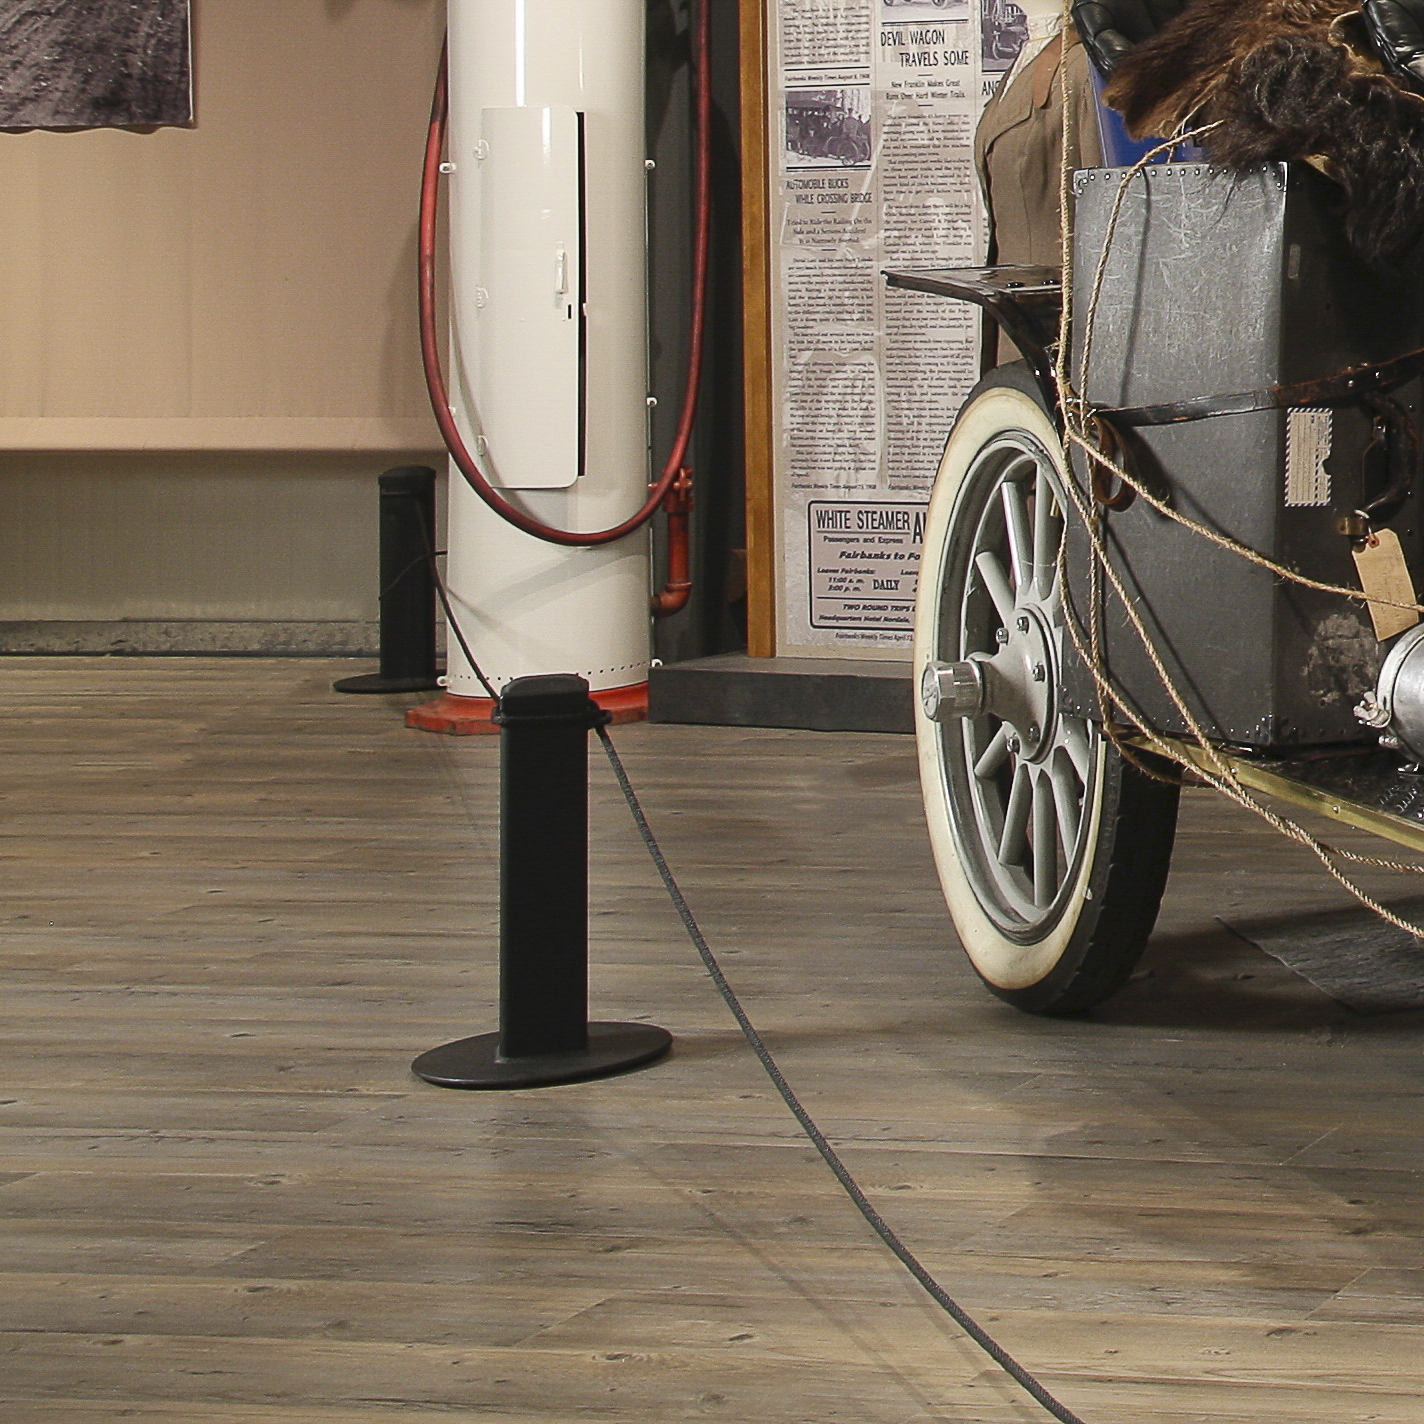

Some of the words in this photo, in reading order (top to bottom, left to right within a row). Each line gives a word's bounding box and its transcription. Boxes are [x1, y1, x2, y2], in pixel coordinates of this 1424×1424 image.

[880, 31, 905, 46] DEVIL
[909, 29, 945, 45] WAGON
[899, 51, 939, 67] TRAVELS
[943, 50, 969, 66] SOME
[785, 178, 826, 190] AUTOMOBILE
[794, 193, 815, 204] WHILE
[816, 192, 849, 204] CROSSING
[850, 192, 873, 204] BRIDGE
[816, 510, 851, 529] WHITE
[856, 510, 911, 531] STEAMER
[823, 535, 860, 544] Passengers
[839, 550, 892, 560] Fairbanks
[894, 551, 905, 560] to
[872, 579, 900, 590] DAILY
[819, 615, 862, 623] Headquarters
